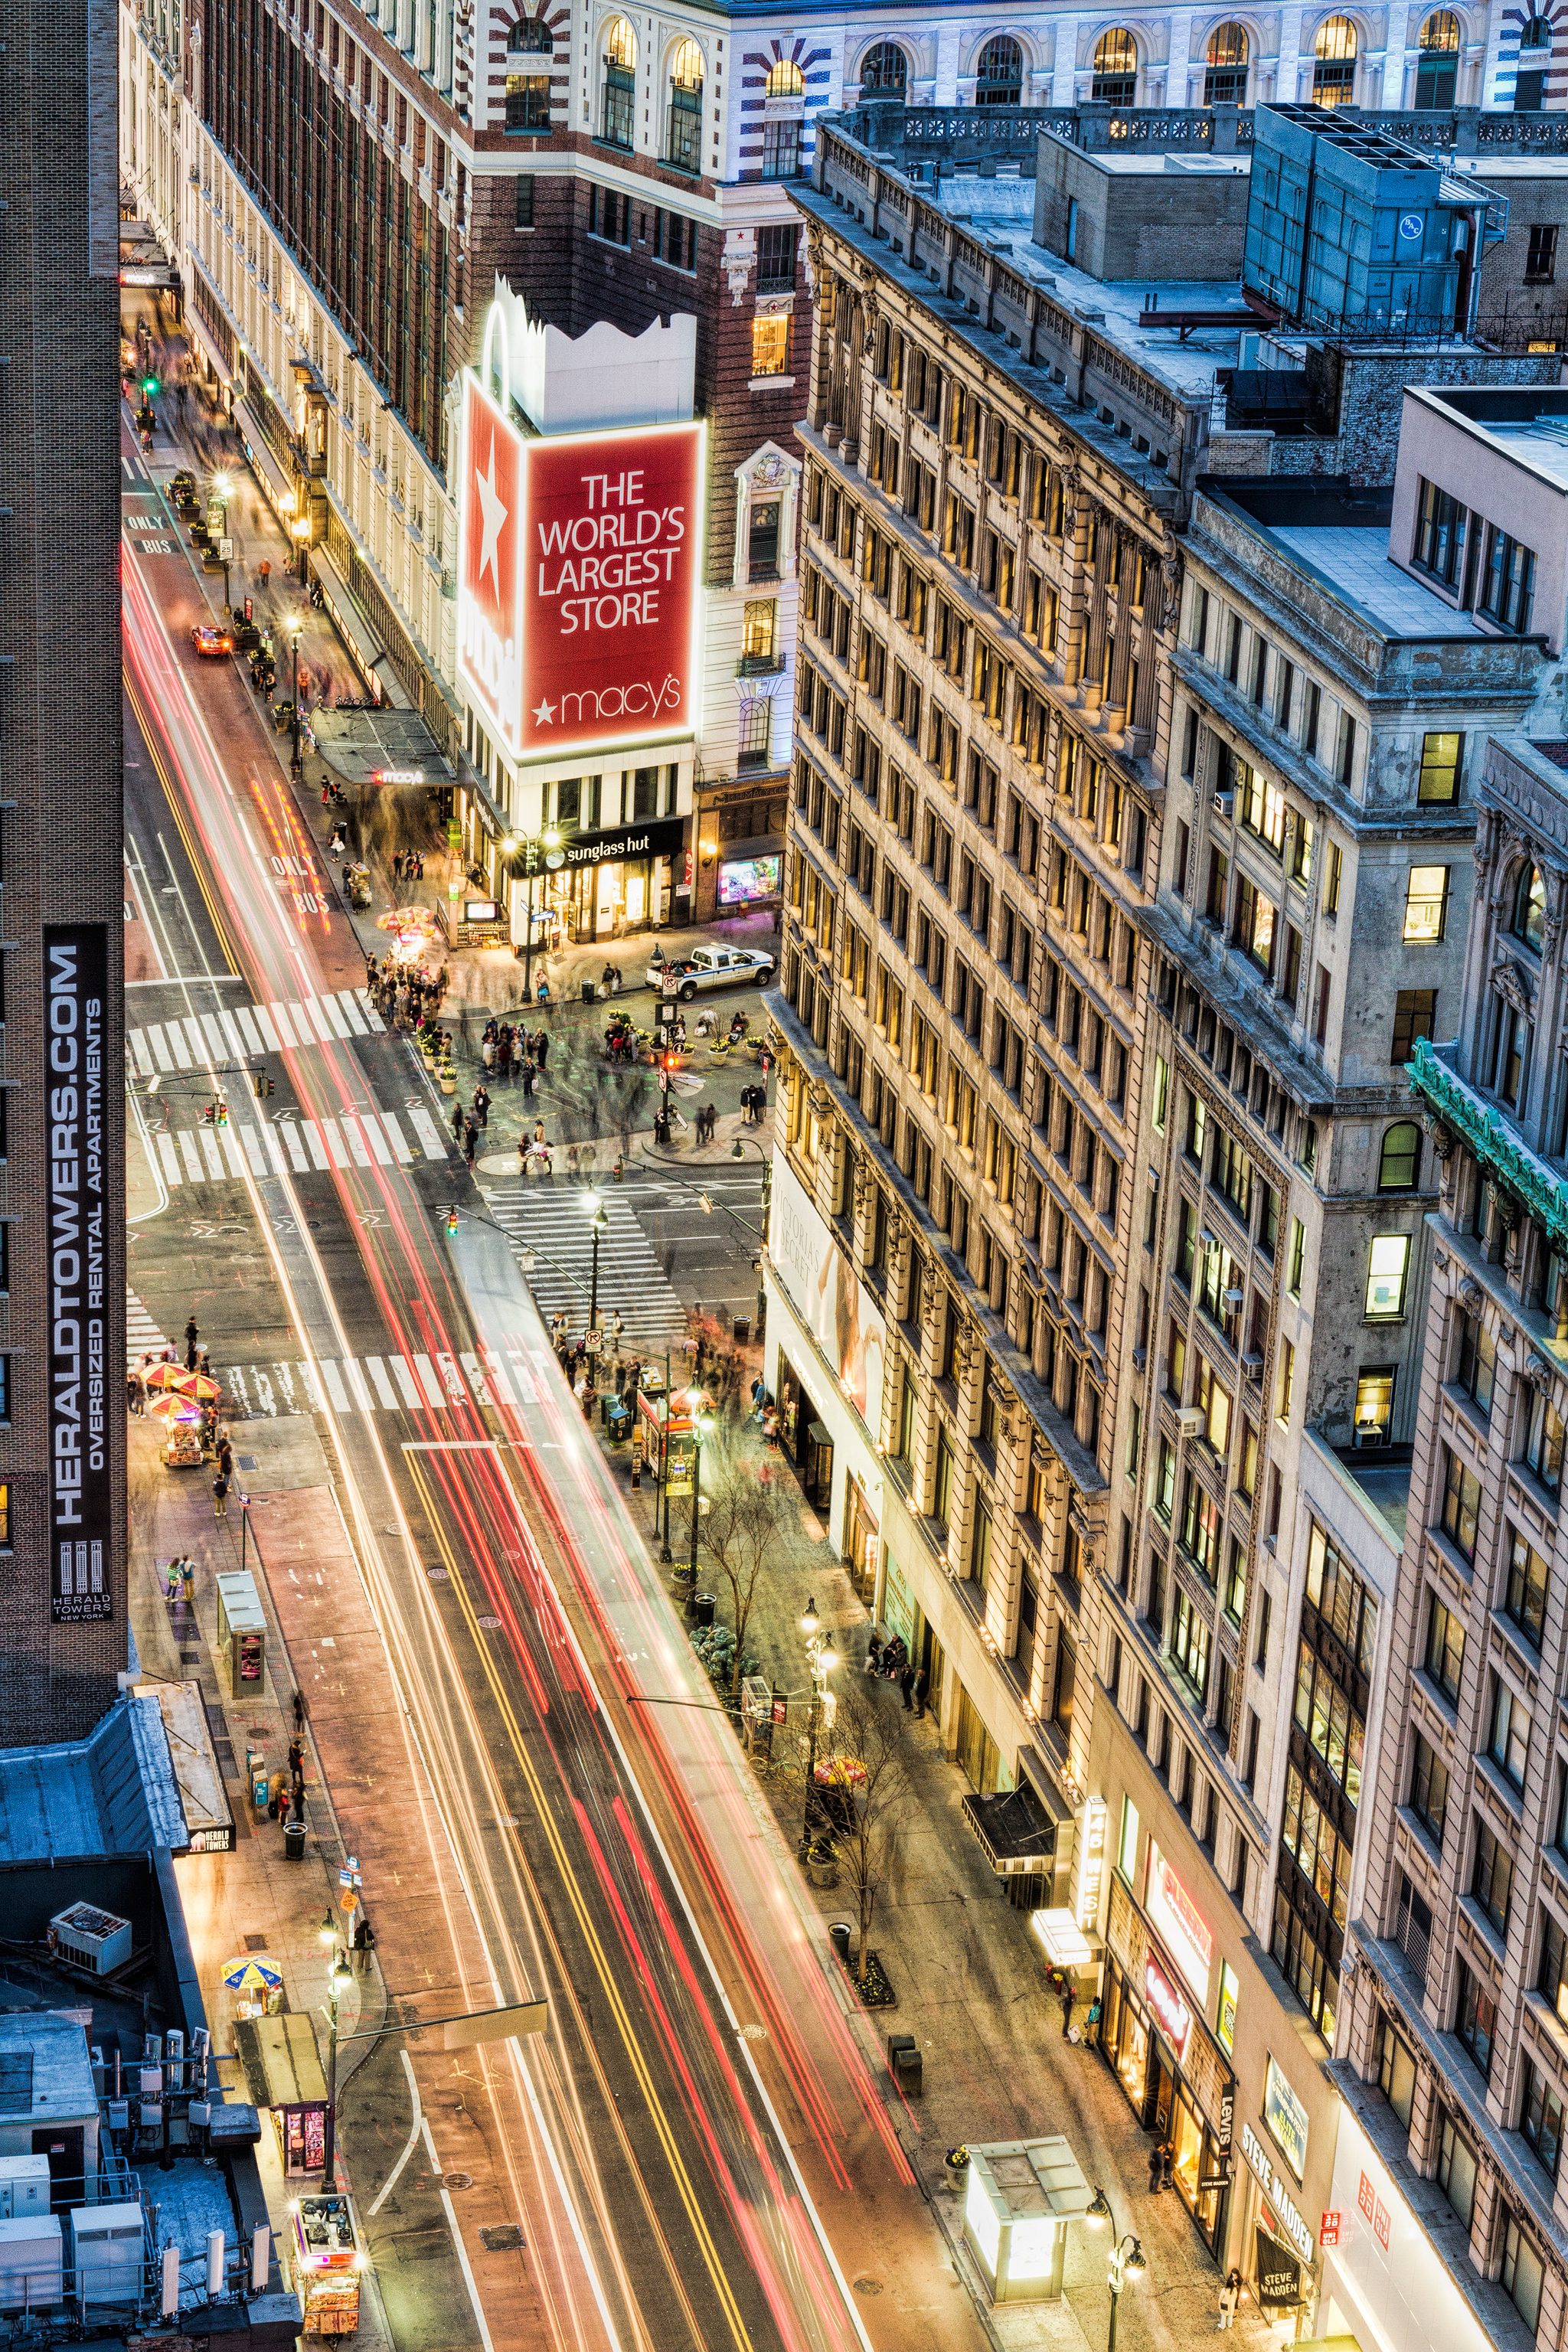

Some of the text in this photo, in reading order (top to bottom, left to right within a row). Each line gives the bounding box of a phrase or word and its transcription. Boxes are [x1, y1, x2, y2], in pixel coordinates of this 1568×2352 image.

[580, 470, 645, 509] THE
[128, 517, 163, 530] ONLY
[538, 507, 684, 556] WORLD'S
[142, 540, 172, 554] BUS
[538, 547, 681, 597] LARGEST
[560, 590, 660, 635] STORE
[561, 673, 681, 724] macy's
[567, 835, 650, 863] sunglass hut
[271, 856, 317, 876] ONLY
[292, 893, 330, 913] BUS
[50, 946, 83, 1524] HERALDTOWERS.COM
[87, 998, 104, 1471] OVERSIZED RENTAL APARTMENTS
[775, 1176, 819, 1272] VICTORIA'S
[781, 1220, 810, 1287] SECRET
[54, 1595, 110, 1606] HERALD
[54, 1603, 110, 1614] TOWERS
[206, 1830, 229, 1841] HERALD
[206, 1841, 229, 1851] TOWERS
[1083, 1858, 1102, 1929] WEST
[1243, 2123, 1315, 2263] STEVE MADDEN
[1377, 2204, 1390, 2229] UNI
[1376, 2220, 1388, 2245] QLO
[1261, 2283, 1298, 2297] MADDEN
[1264, 2272, 1292, 2286] STEVE
